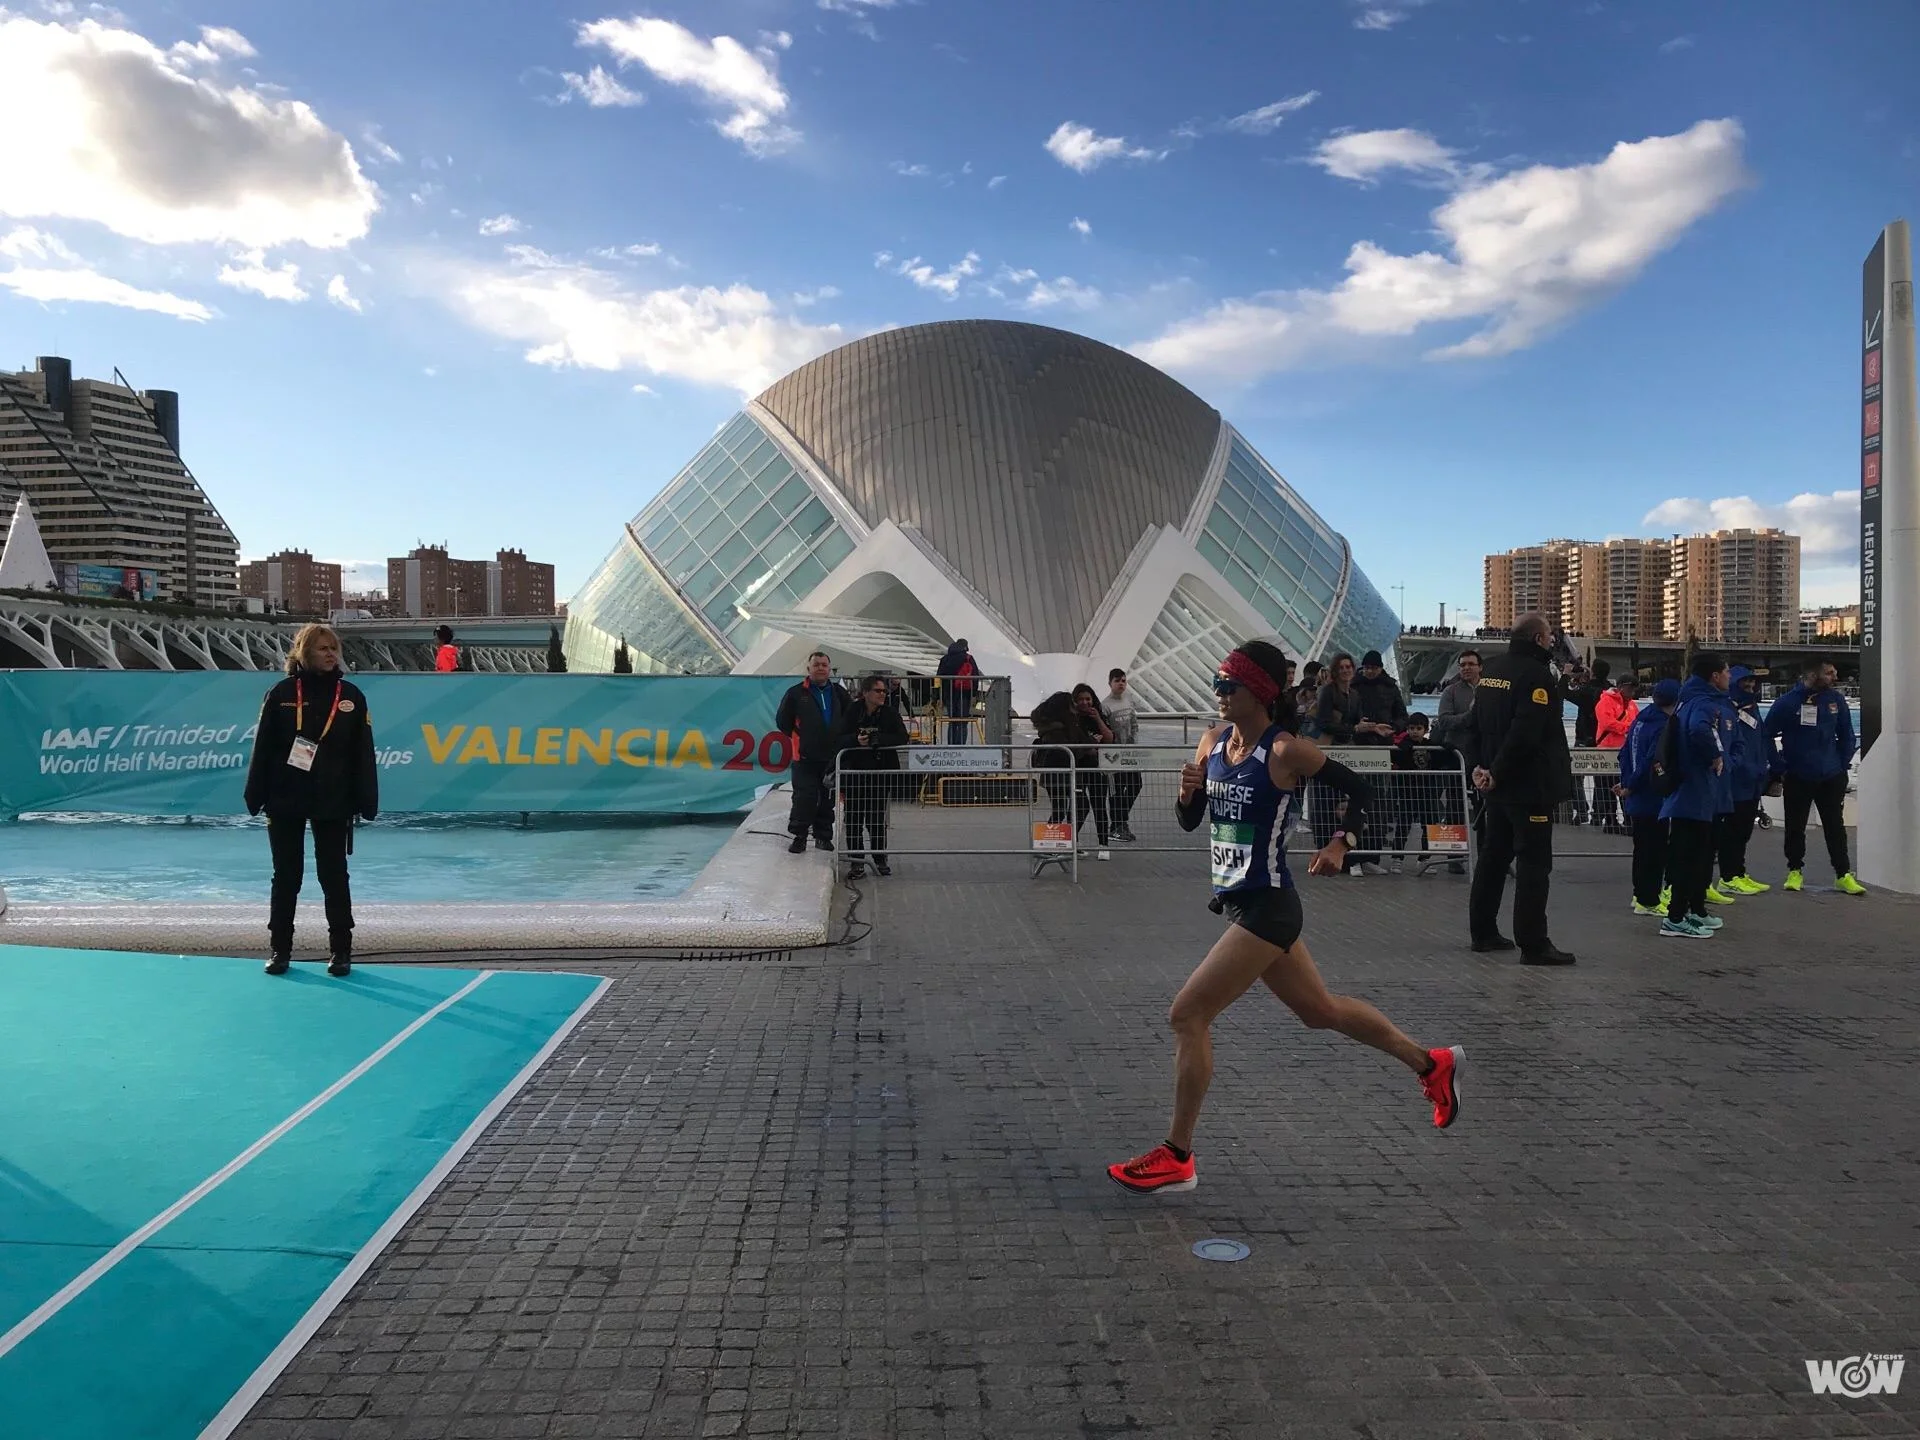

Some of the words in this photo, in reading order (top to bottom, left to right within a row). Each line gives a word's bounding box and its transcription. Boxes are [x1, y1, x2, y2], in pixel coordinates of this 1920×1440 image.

[1864, 522, 1876, 647] HEMISFÈRIC
[1478, 678, 1511, 690] ROSEGUR
[132, 724, 237, 747] Trinidad
[374, 746, 414, 769] hips
[421, 724, 713, 769] VALENCIA
[721, 729, 792, 774] 20
[39, 754, 100, 775] World
[104, 752, 144, 773] Half
[147, 750, 243, 772] Marathon
[1208, 798, 1243, 821] TAIPEI
[1213, 845, 1245, 868] SIEH
